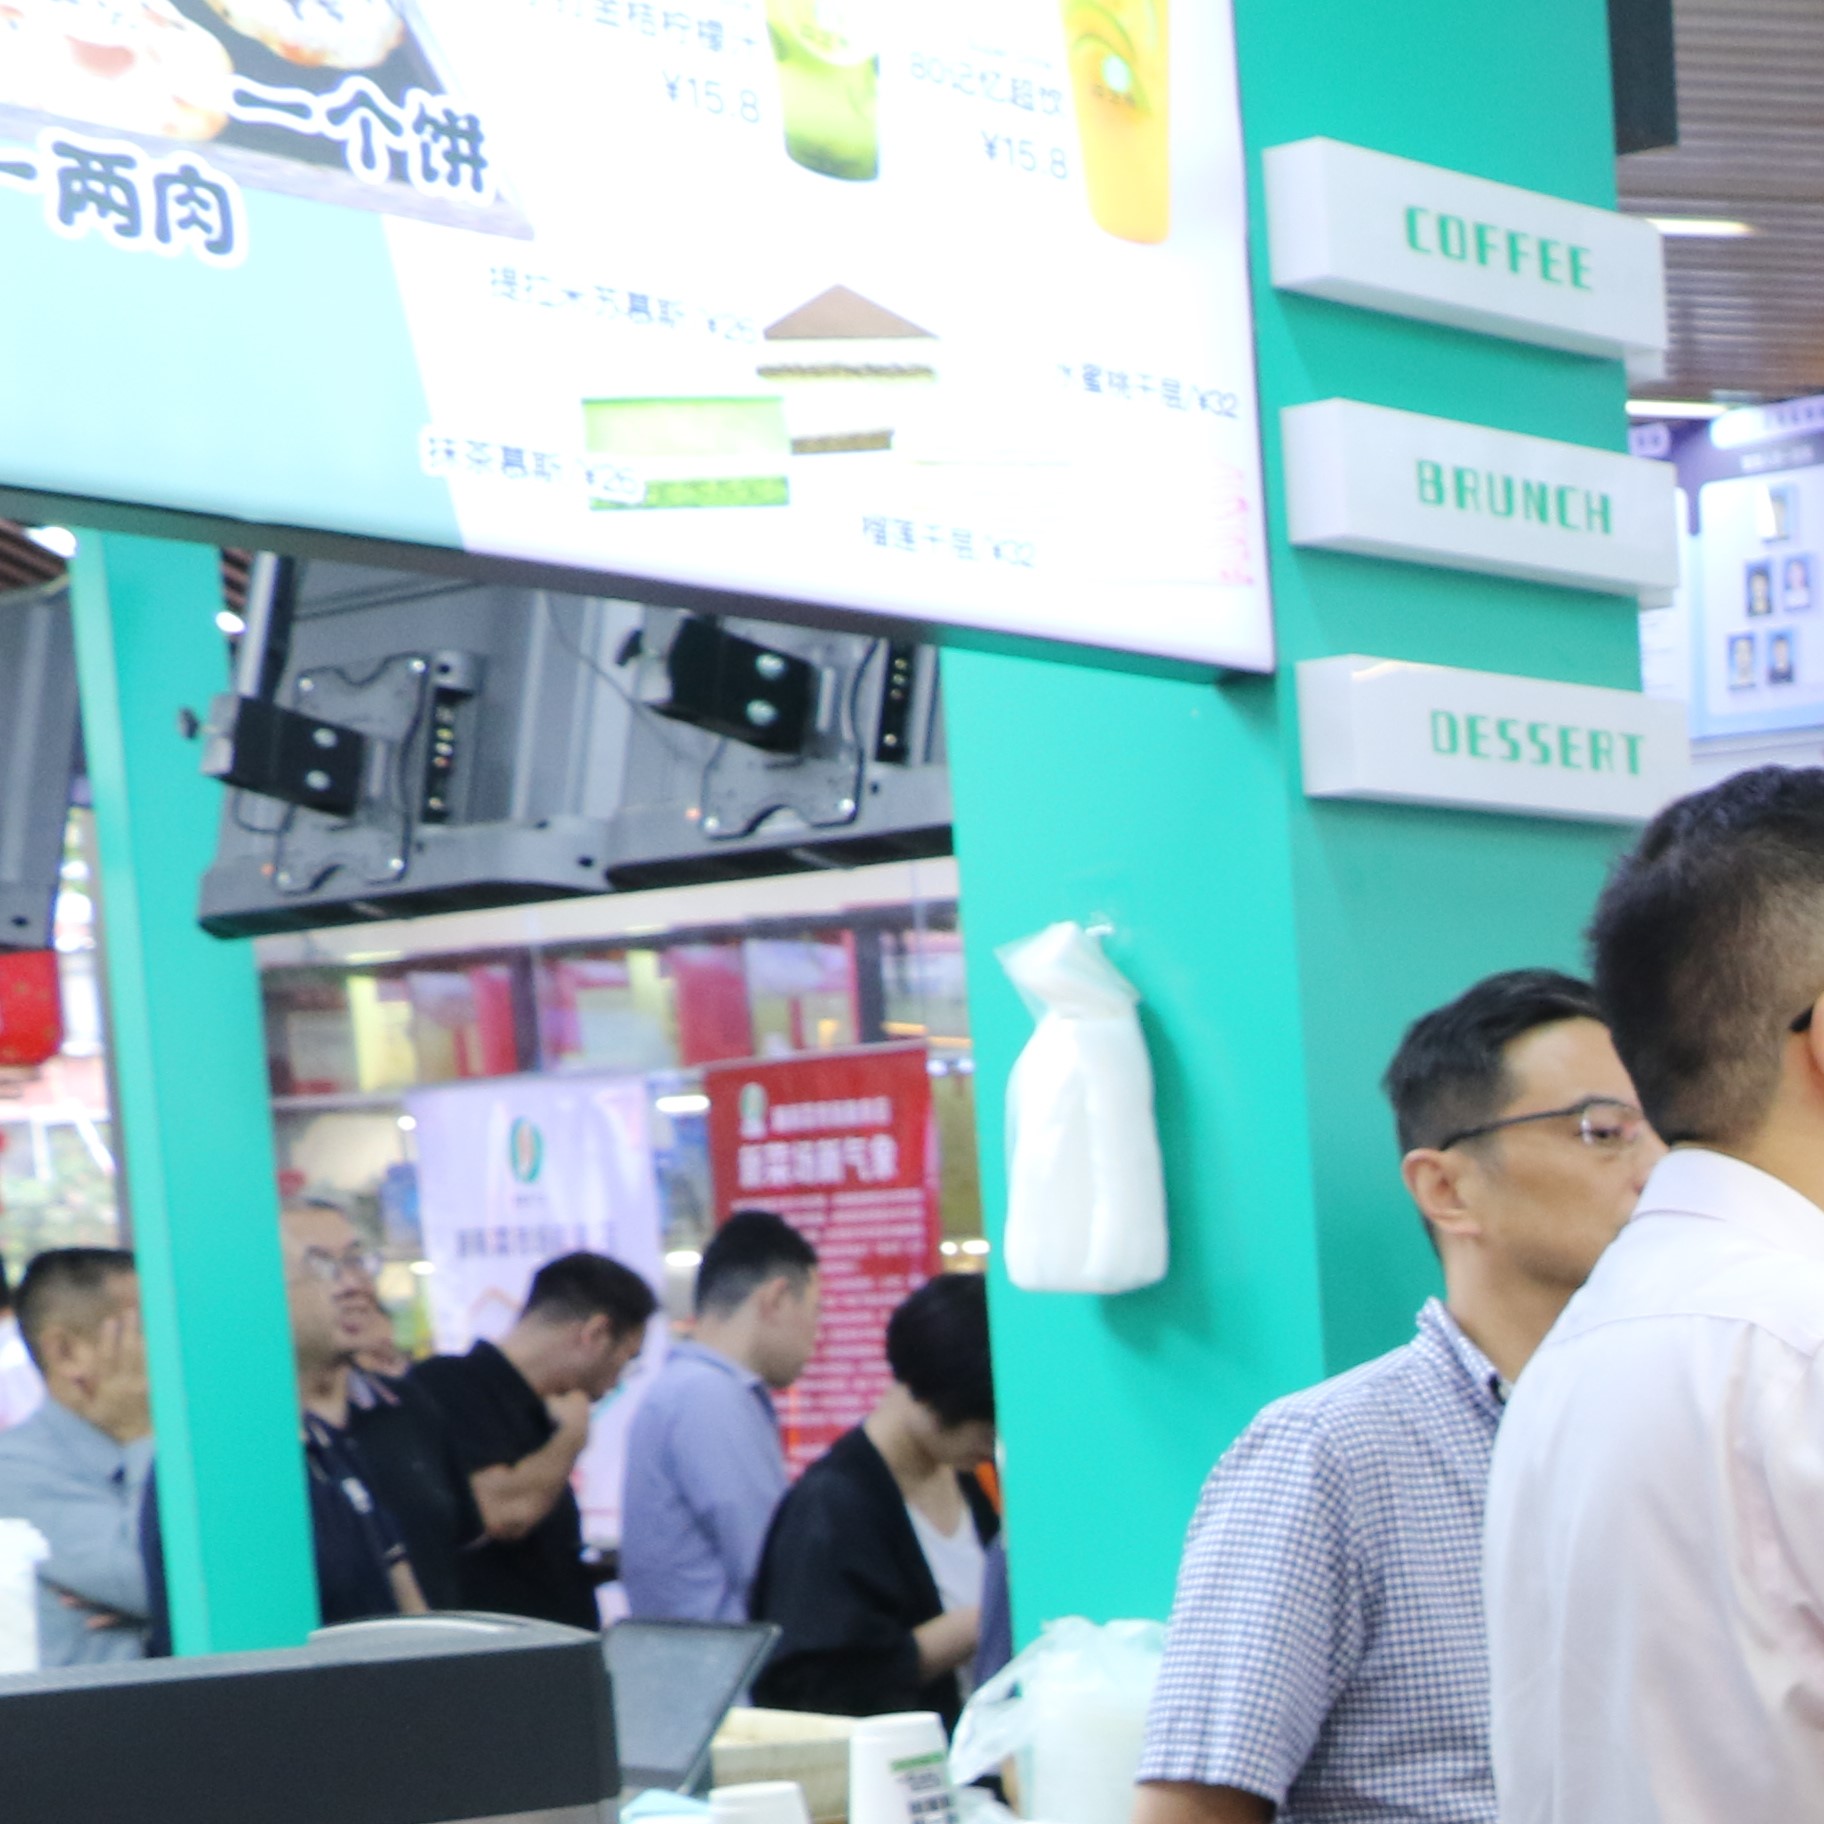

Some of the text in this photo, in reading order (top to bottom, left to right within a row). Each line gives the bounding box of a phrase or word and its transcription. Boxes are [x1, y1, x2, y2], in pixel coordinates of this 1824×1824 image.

[232, 87, 491, 194] 一个饼
[980, 129, 1069, 181] ¥15.8
[1404, 204, 1594, 292] COFFEE
[1415, 458, 1613, 536] BRUNCH
[1429, 707, 1646, 776] DESSERT
